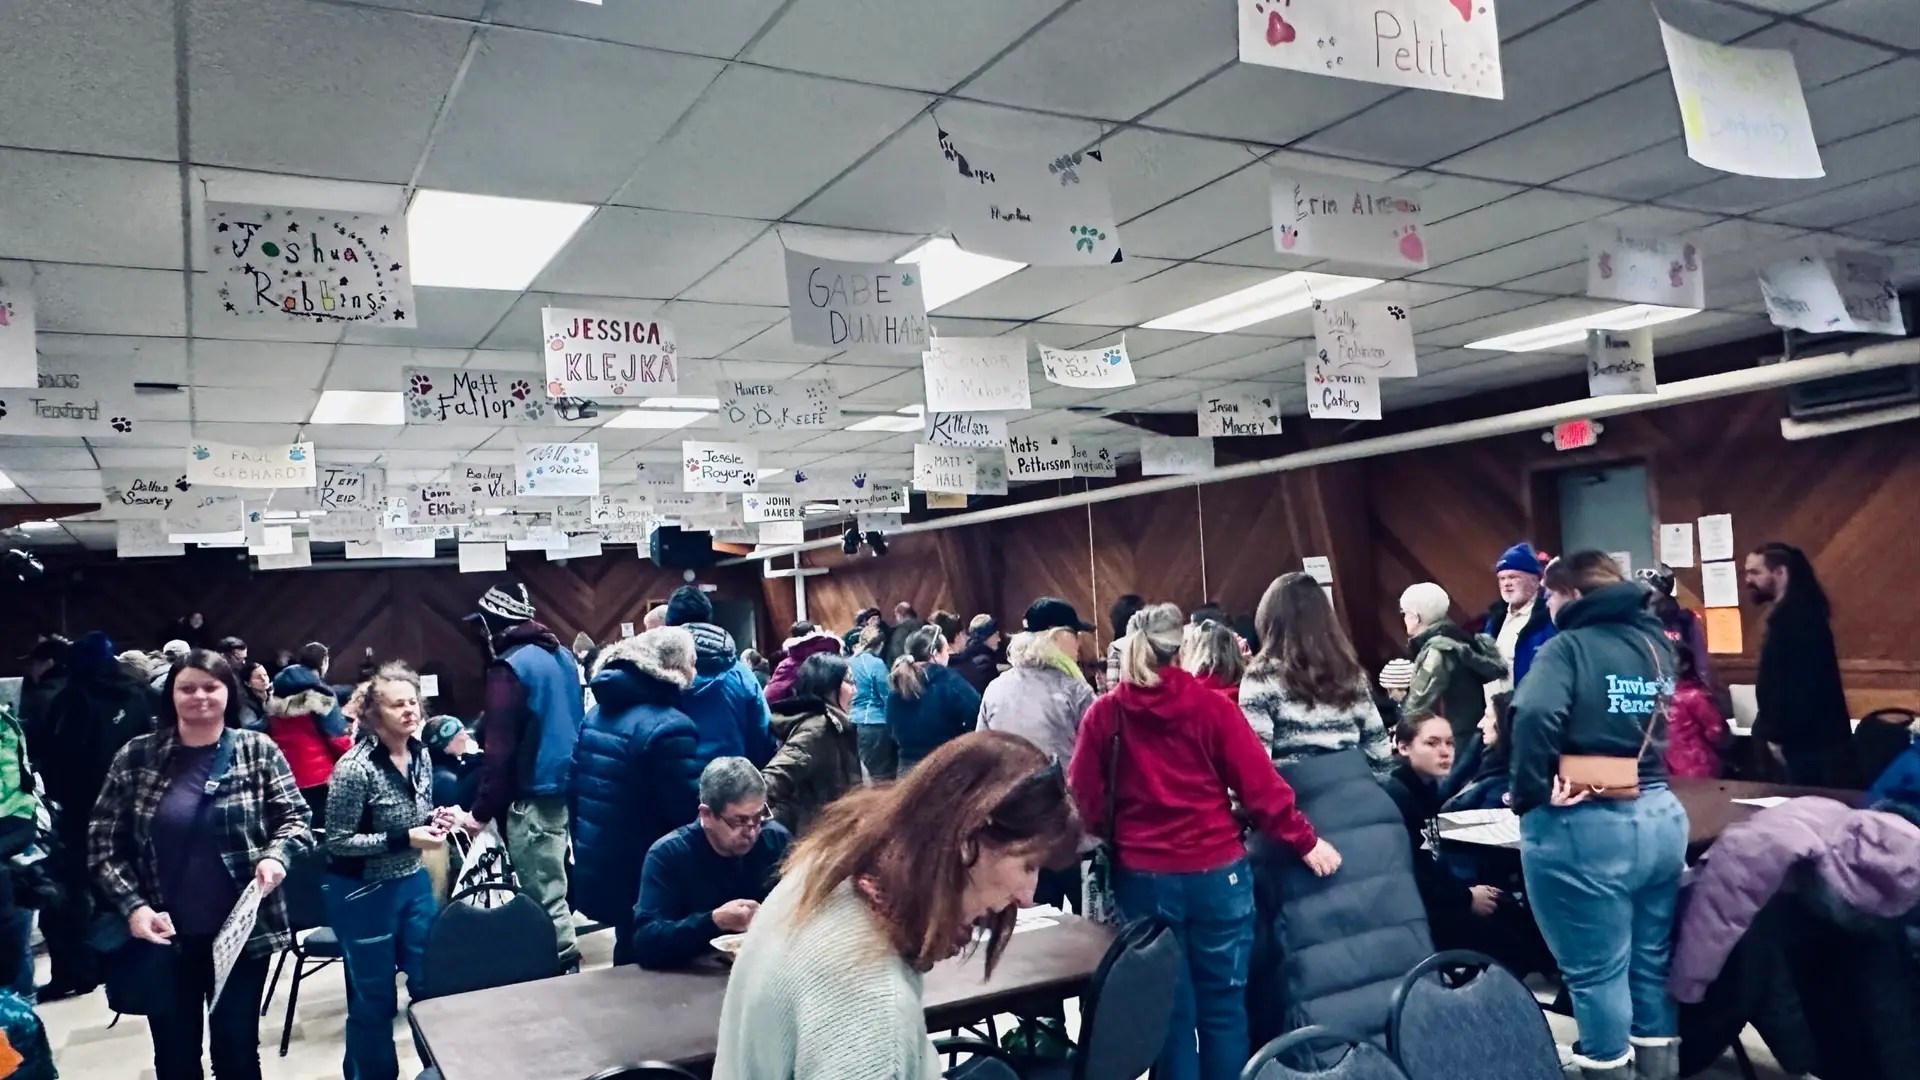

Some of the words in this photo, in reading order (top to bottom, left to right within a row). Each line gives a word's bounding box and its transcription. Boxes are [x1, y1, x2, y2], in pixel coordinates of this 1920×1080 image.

[1374, 10, 1451, 77] Petit
[1294, 184, 1338, 222] Erin
[232, 221, 358, 263] Joshua
[255, 271, 378, 312] Robbins
[808, 266, 892, 308] GABE
[567, 317, 660, 345] JESSICA
[565, 353, 676, 382] KLEJKA
[453, 372, 499, 402] Matt
[231, 451, 273, 463] PAUL
[1009, 436, 1040, 453] Mats
[212, 466, 307, 480] GEBHARDT
[702, 465, 744, 484] Royer
[934, 455, 961, 468] MATT
[936, 473, 964, 487] HALL
[766, 497, 791, 506] JOHN
